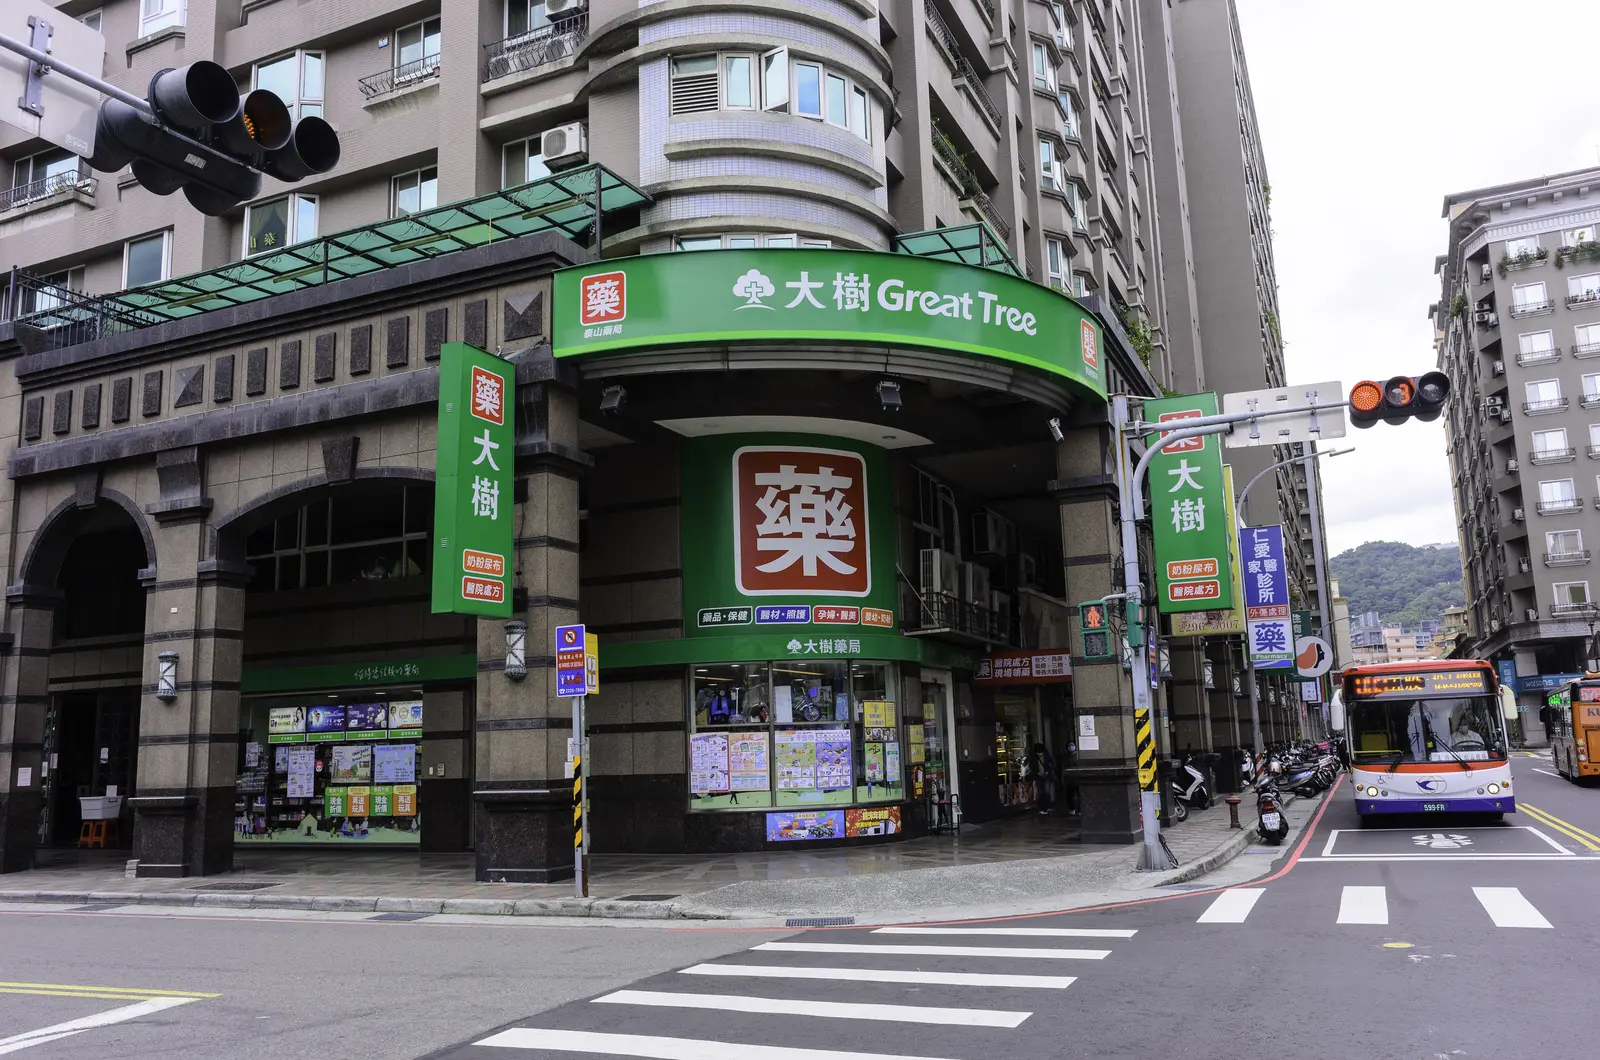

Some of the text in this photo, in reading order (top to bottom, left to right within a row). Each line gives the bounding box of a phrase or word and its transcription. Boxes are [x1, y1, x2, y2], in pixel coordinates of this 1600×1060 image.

[587, 280, 620, 317] 藥
[785, 271, 1037, 336] 大樹 Great Tree
[583, 324, 623, 338] 泰山藥局
[475, 374, 501, 418] 藥
[471, 428, 500, 521] 大樹
[1168, 459, 1205, 534] 大樹
[755, 464, 858, 577] 藥
[467, 555, 502, 571] 奶粉尿布
[1171, 563, 1214, 576] 奶粉尿布
[466, 582, 501, 598] 醫院處方
[1173, 584, 1216, 597] 醫院處方
[1249, 606, 1288, 617] 外傷處理
[1254, 622, 1286, 652] 藥
[803, 639, 861, 654] 大樹藥局
[994, 657, 1031, 668] 醫院處方
